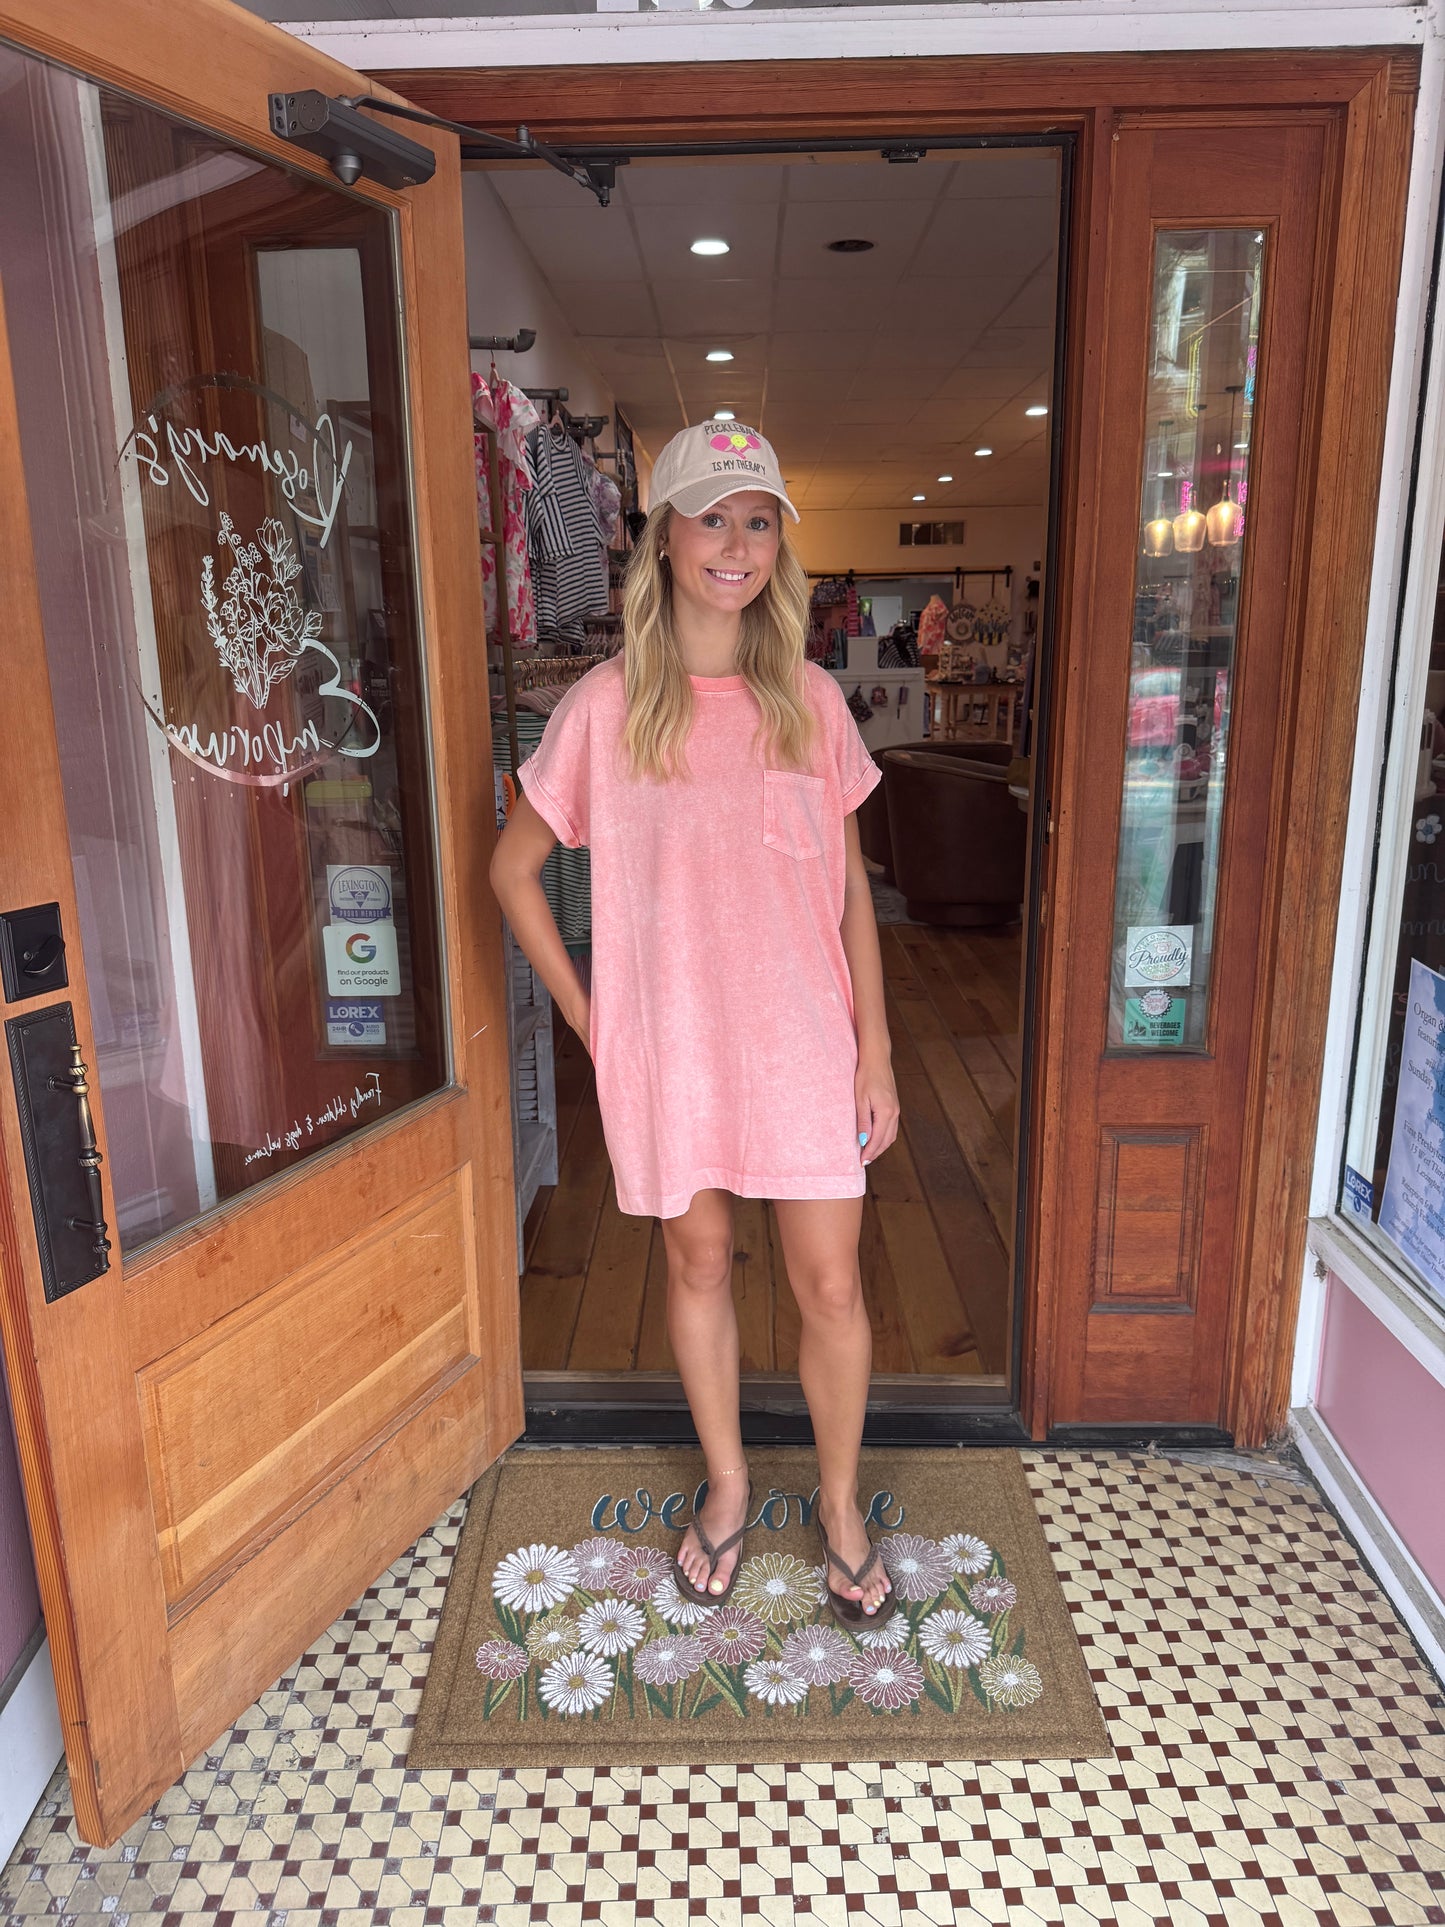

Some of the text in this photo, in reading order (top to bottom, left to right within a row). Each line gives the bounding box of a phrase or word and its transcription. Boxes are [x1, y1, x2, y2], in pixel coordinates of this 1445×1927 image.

[704, 423, 760, 440] PICKLEBALL
[712, 459, 766, 476] IS MY THERAPY
[338, 879, 381, 893] LEXINGTON
[360, 910, 384, 918] MEMBER
[1129, 947, 1188, 968] Proudly
[354, 976, 388, 987] Google
[329, 1006, 380, 1019] LOREX
[1413, 1002, 1437, 1028] Organ
[1408, 1060, 1433, 1091] Sunday,
[1346, 1171, 1371, 1202] LOREX
